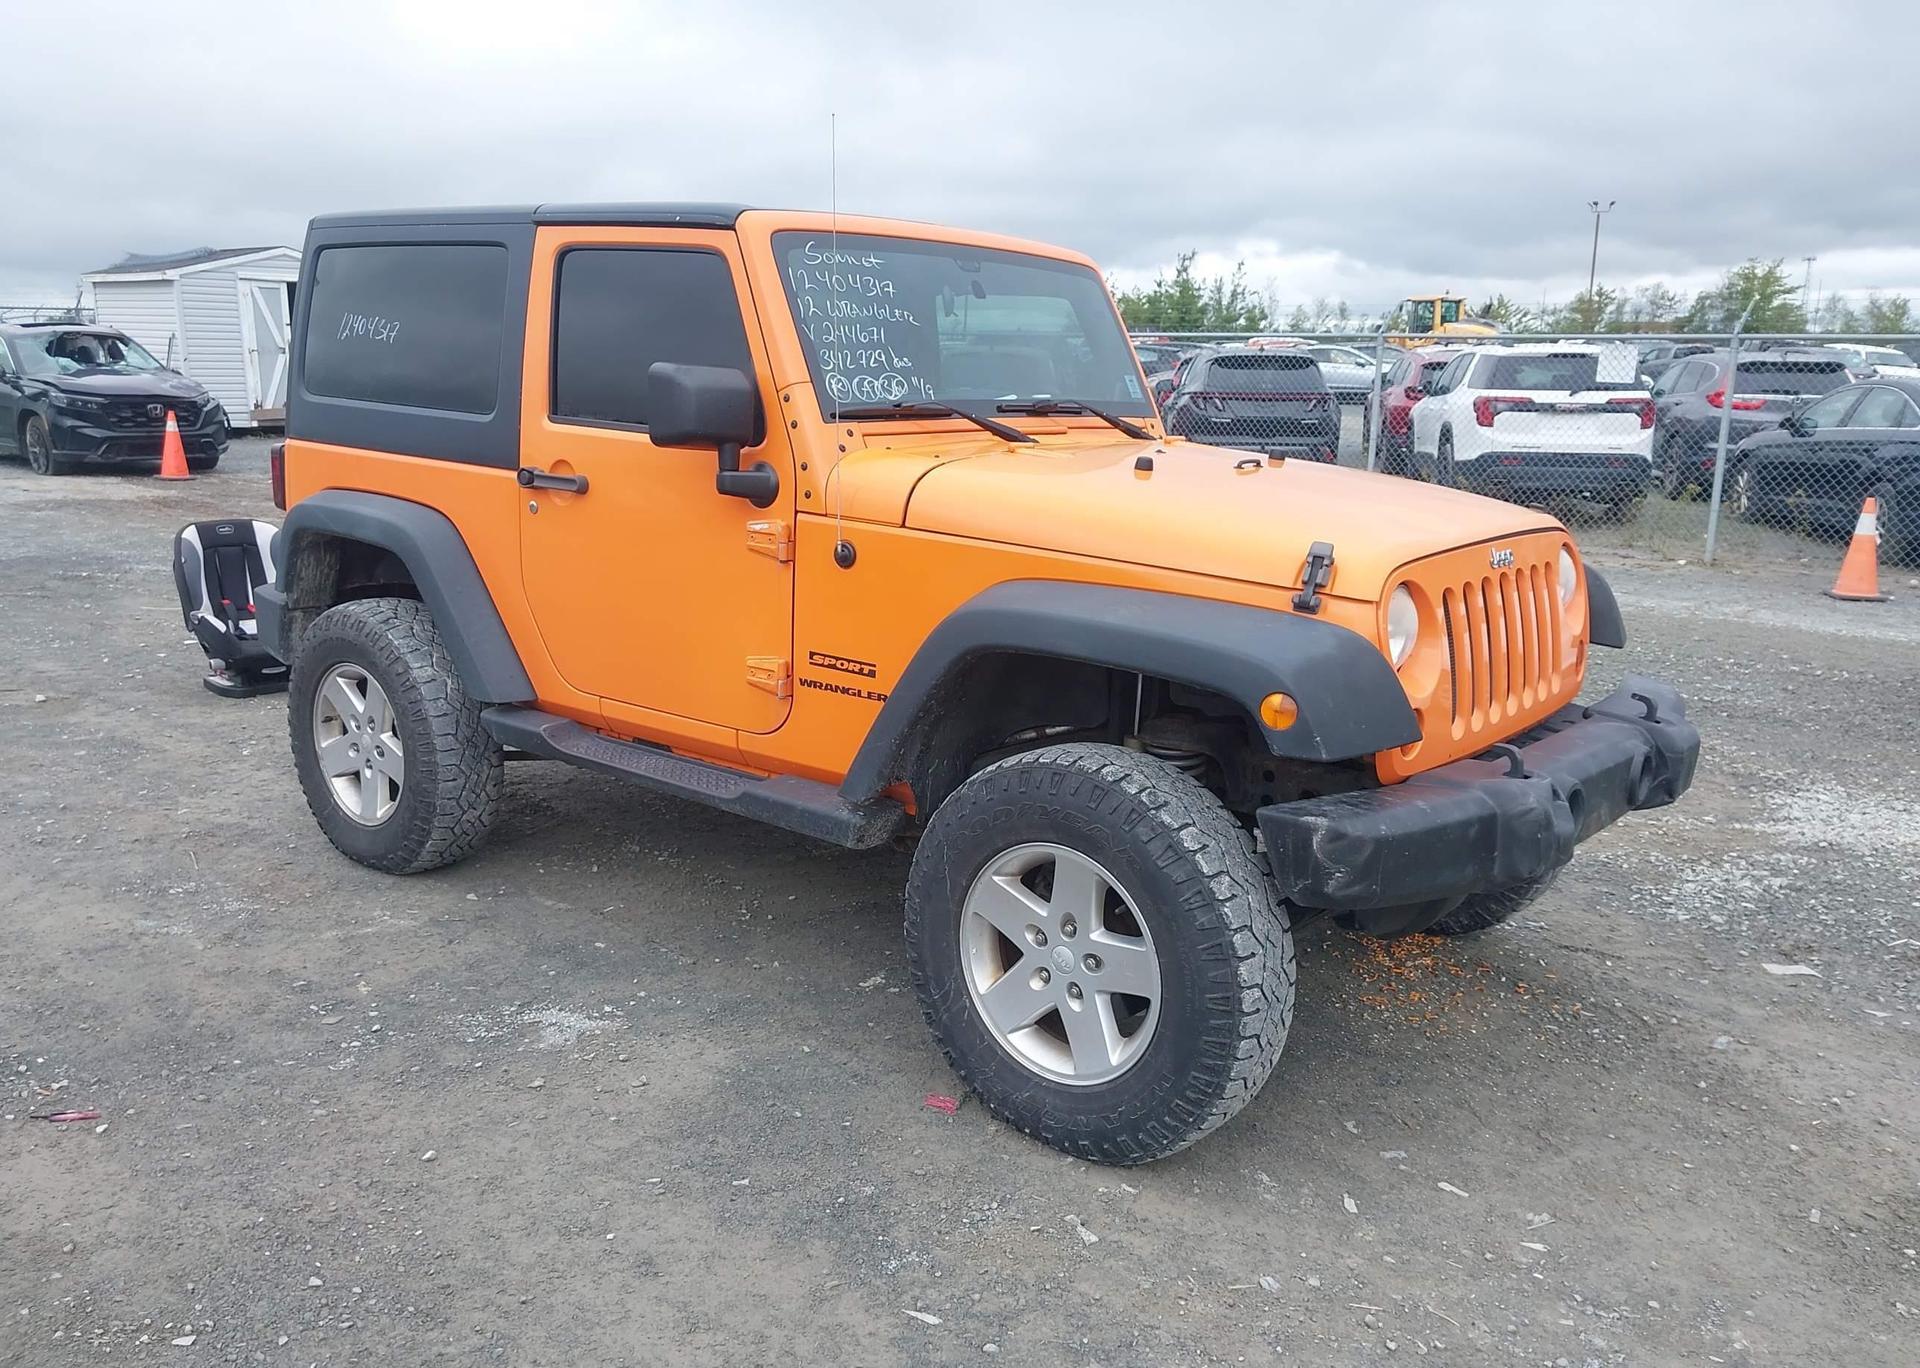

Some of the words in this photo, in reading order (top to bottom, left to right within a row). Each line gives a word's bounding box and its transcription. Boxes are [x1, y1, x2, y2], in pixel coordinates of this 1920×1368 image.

[788, 267, 896, 298] 12404317
[797, 296, 823, 318] 12
[822, 321, 885, 345] 244671
[812, 654, 876, 675] SPORT
[799, 677, 889, 703] WRANGLER
